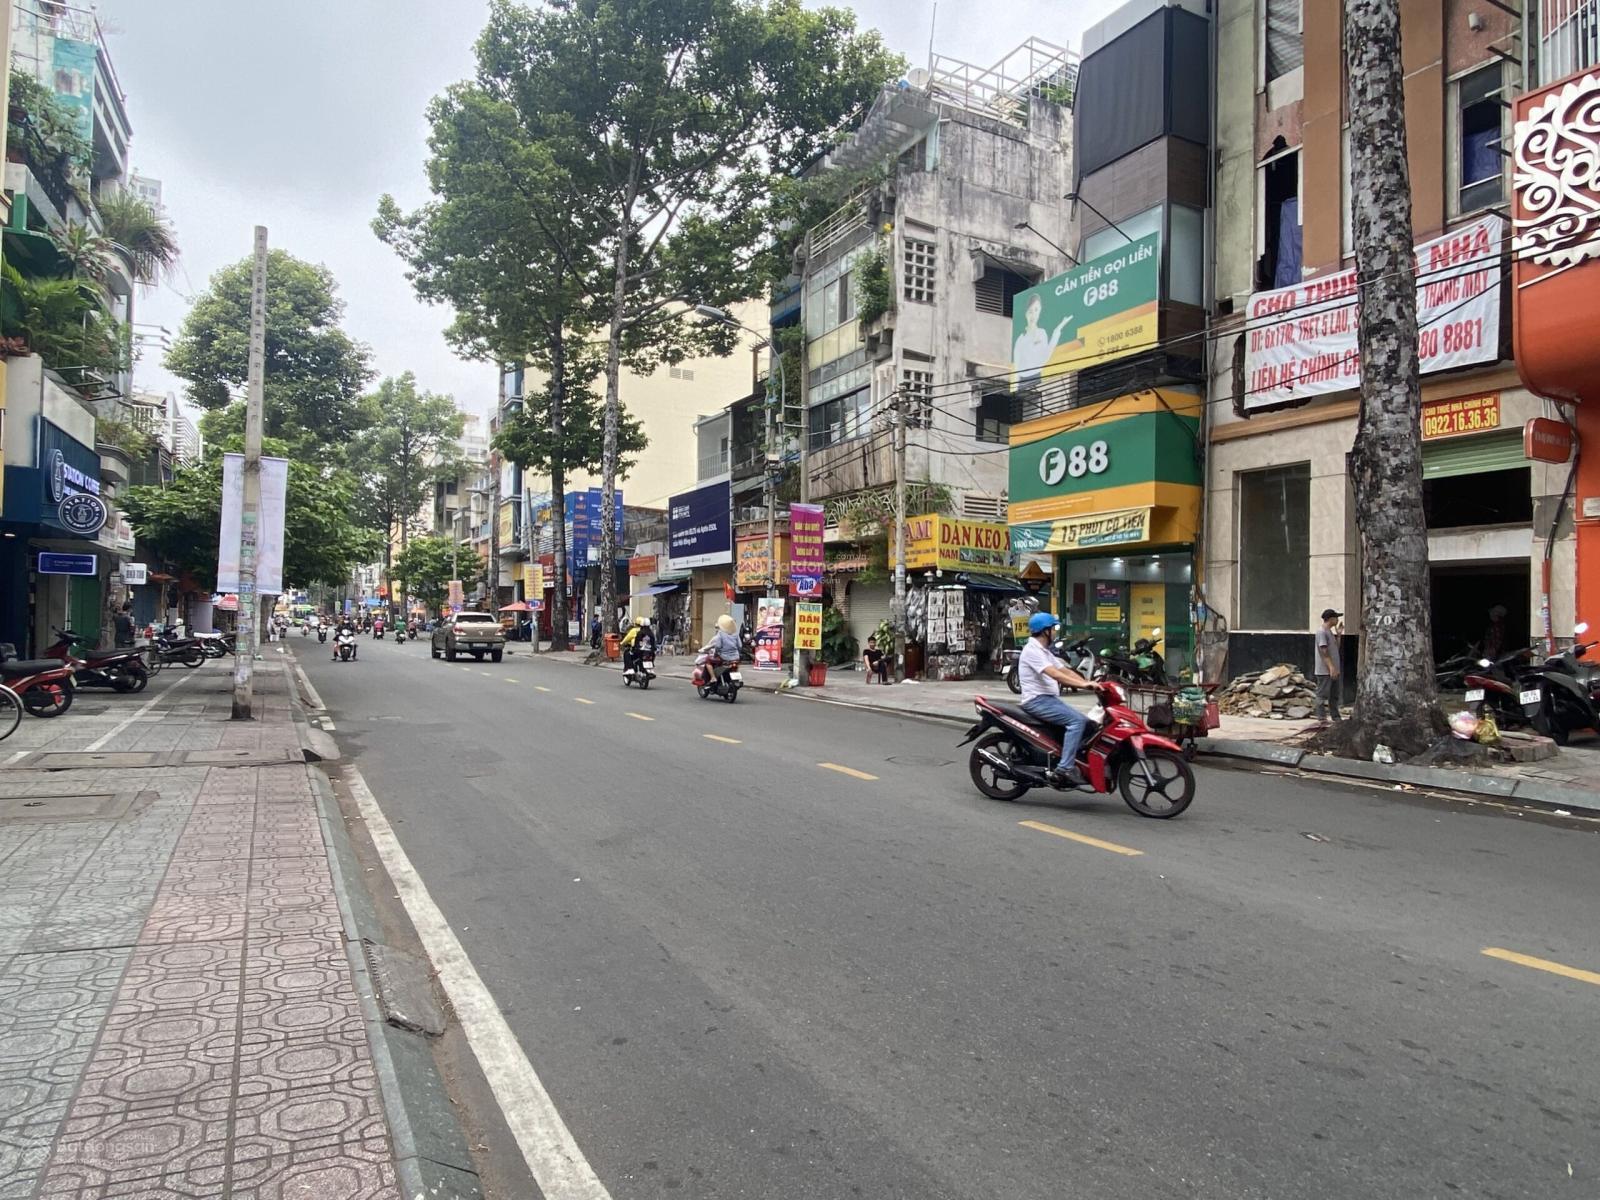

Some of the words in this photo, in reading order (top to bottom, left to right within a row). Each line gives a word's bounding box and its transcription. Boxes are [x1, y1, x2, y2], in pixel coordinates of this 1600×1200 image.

[1430, 225, 1490, 271] NHÀ
[1104, 256, 1126, 273] GỌI
[1083, 279, 1119, 307] F88
[1443, 318, 1483, 354] 8881
[1300, 350, 1339, 385] CHÍNH
[1425, 407, 1497, 436] 0922.16.36.36
[1039, 440, 1109, 486] F88
[941, 519, 971, 546] DÁN
[974, 526, 1001, 550] KEO
[1061, 524, 1077, 543] 15
